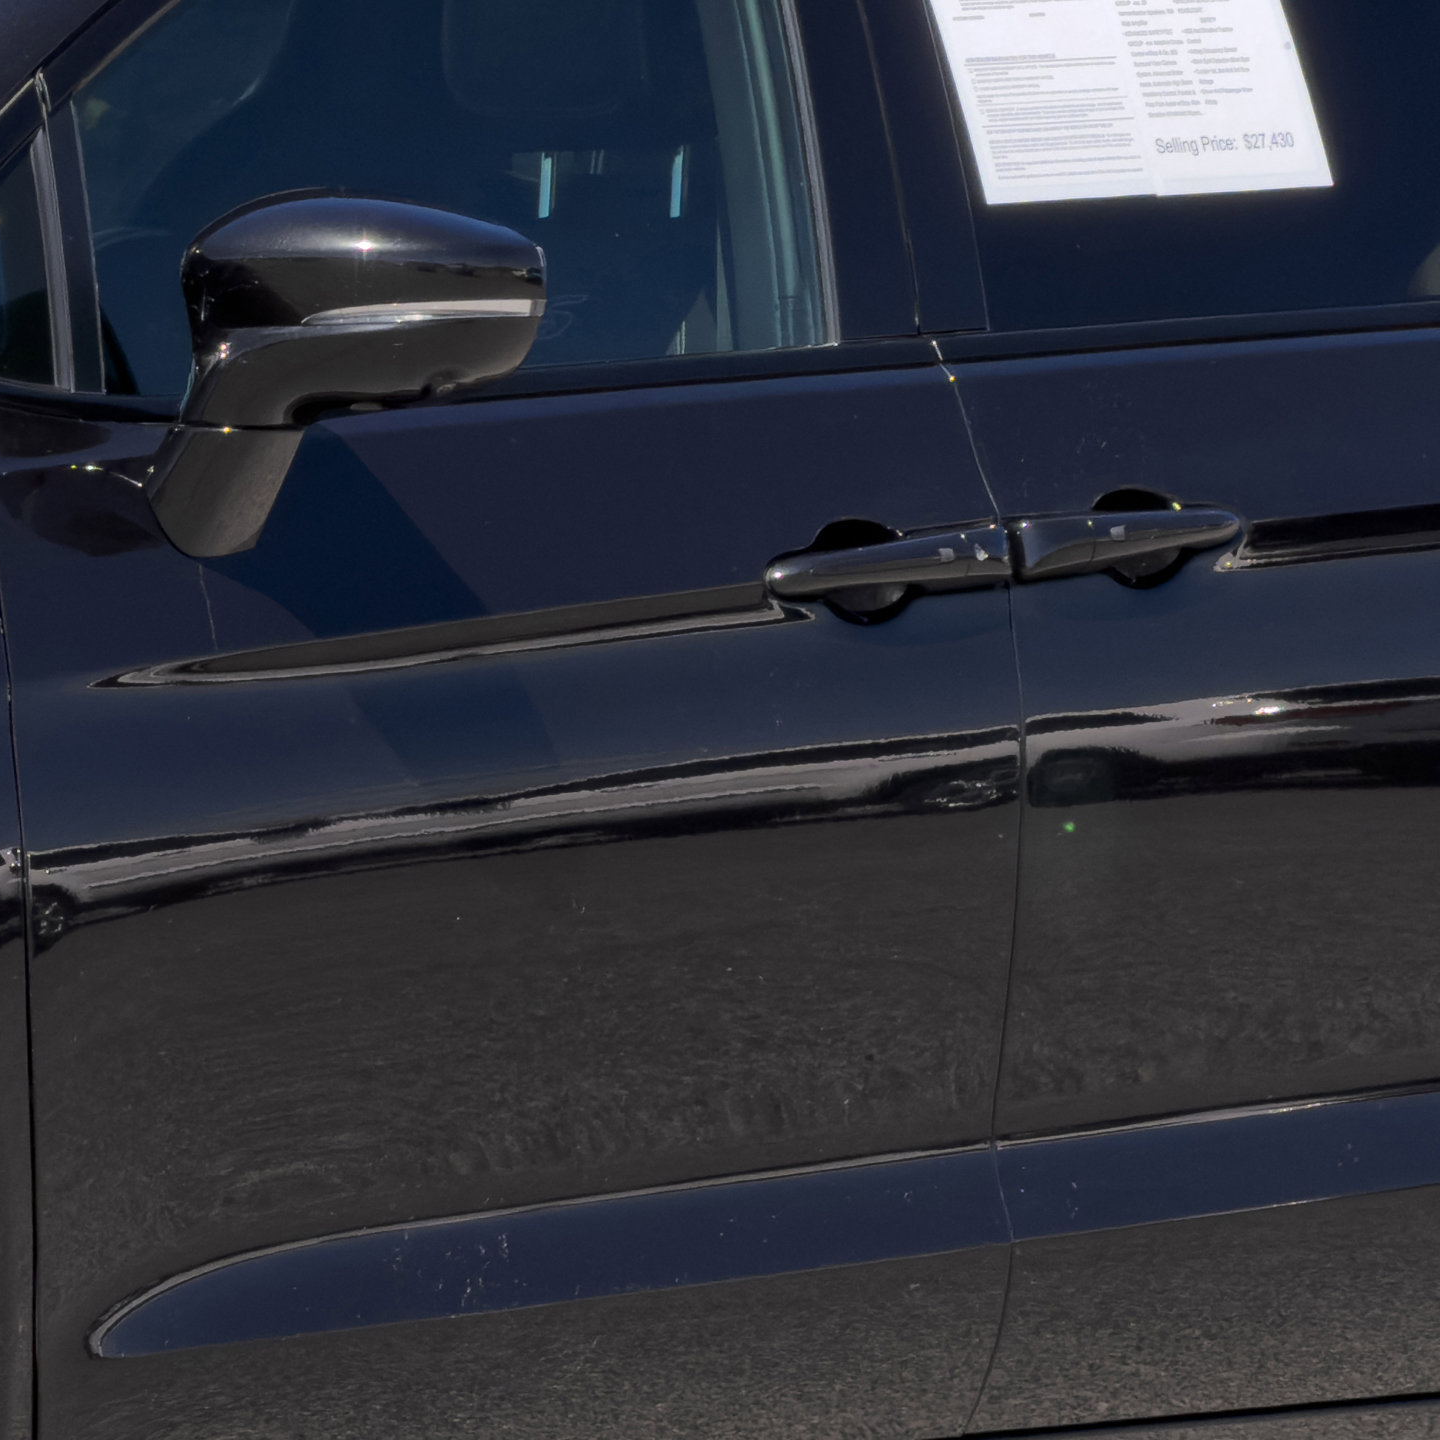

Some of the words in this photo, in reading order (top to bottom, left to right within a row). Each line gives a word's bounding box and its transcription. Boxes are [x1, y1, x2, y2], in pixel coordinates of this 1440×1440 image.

[1155, 137, 1200, 156] Selling
[1201, 136, 1239, 152] Price:
[1242, 131, 1296, 151] $27,430
